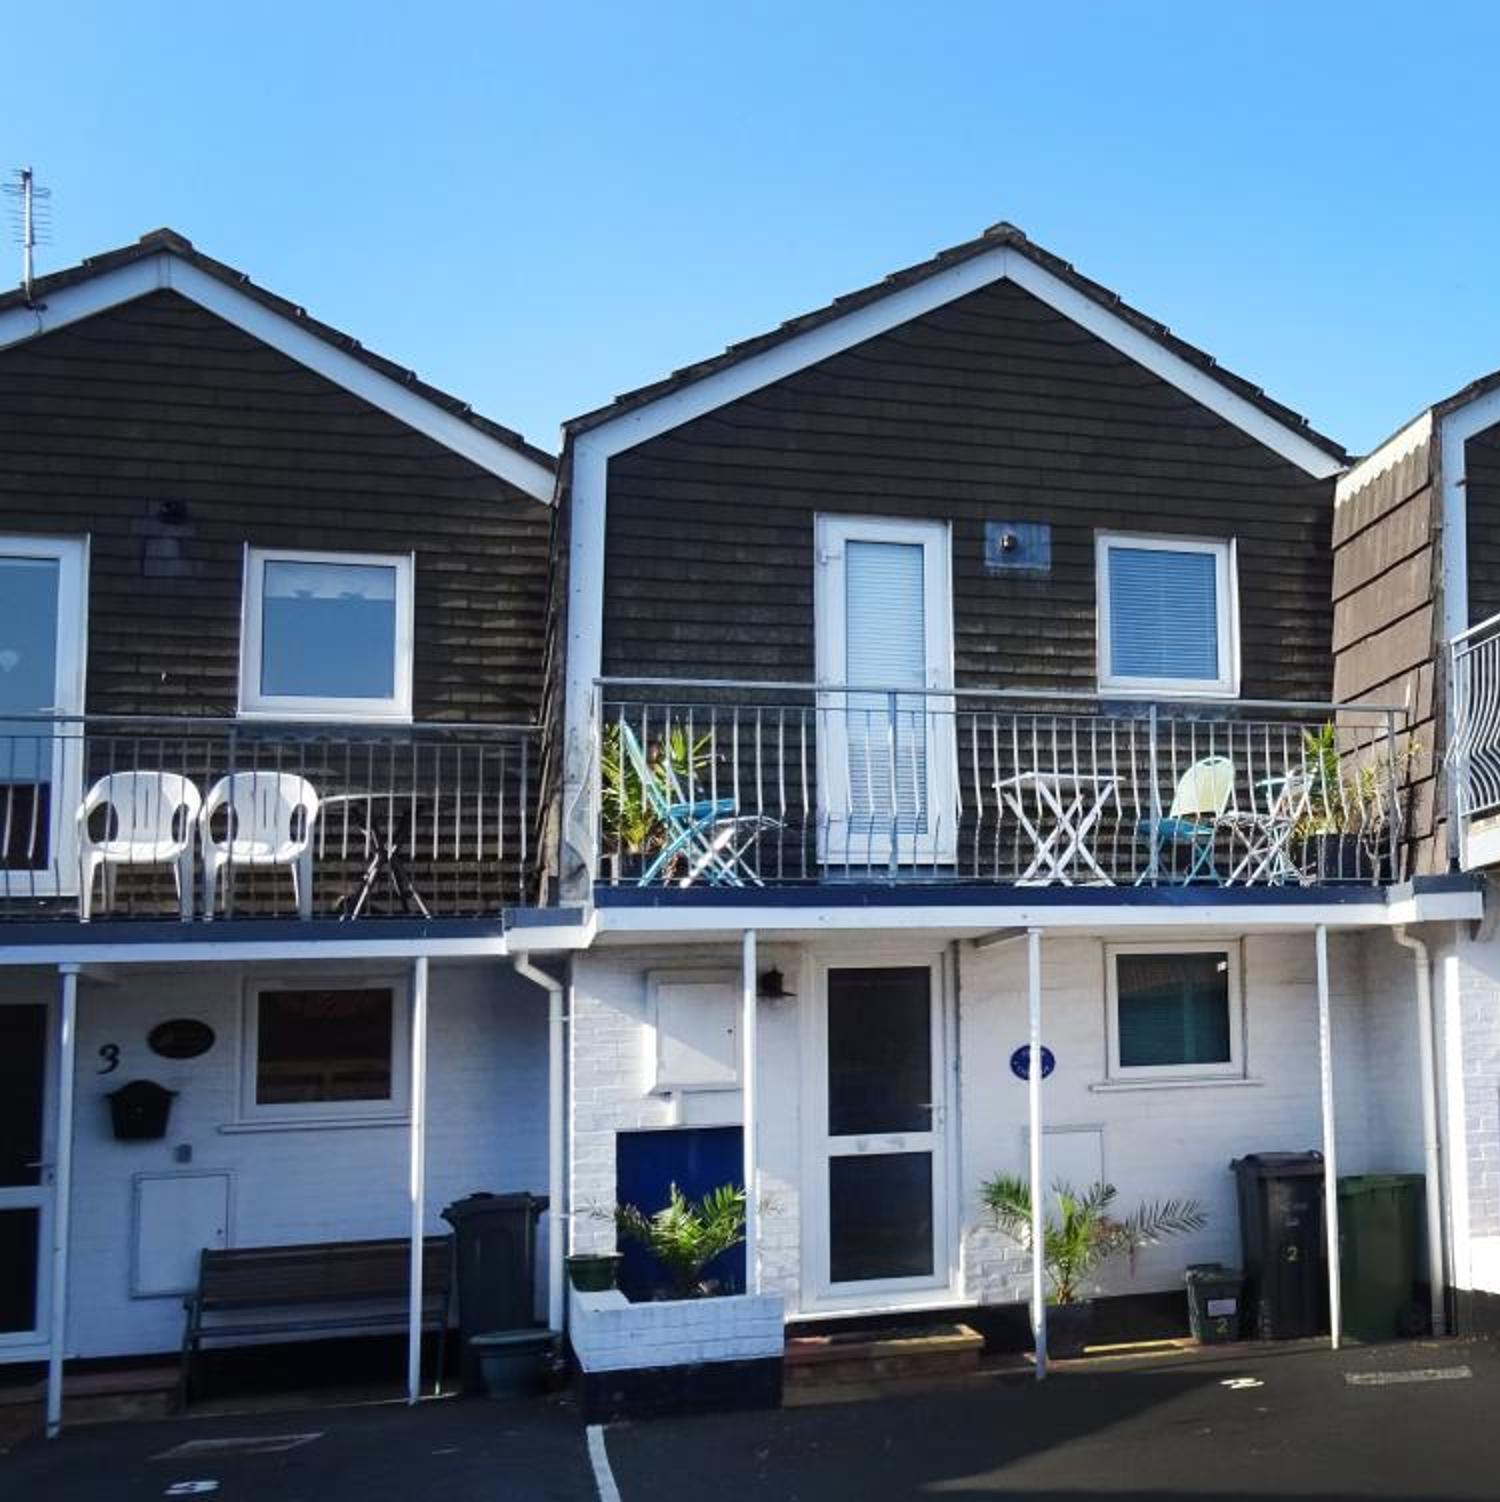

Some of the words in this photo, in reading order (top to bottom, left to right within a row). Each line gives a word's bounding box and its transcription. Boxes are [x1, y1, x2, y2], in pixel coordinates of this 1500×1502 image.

[98, 1043, 119, 1075] 3
[1286, 1245, 1297, 1261] 2
[1216, 1317, 1230, 1334] 2
